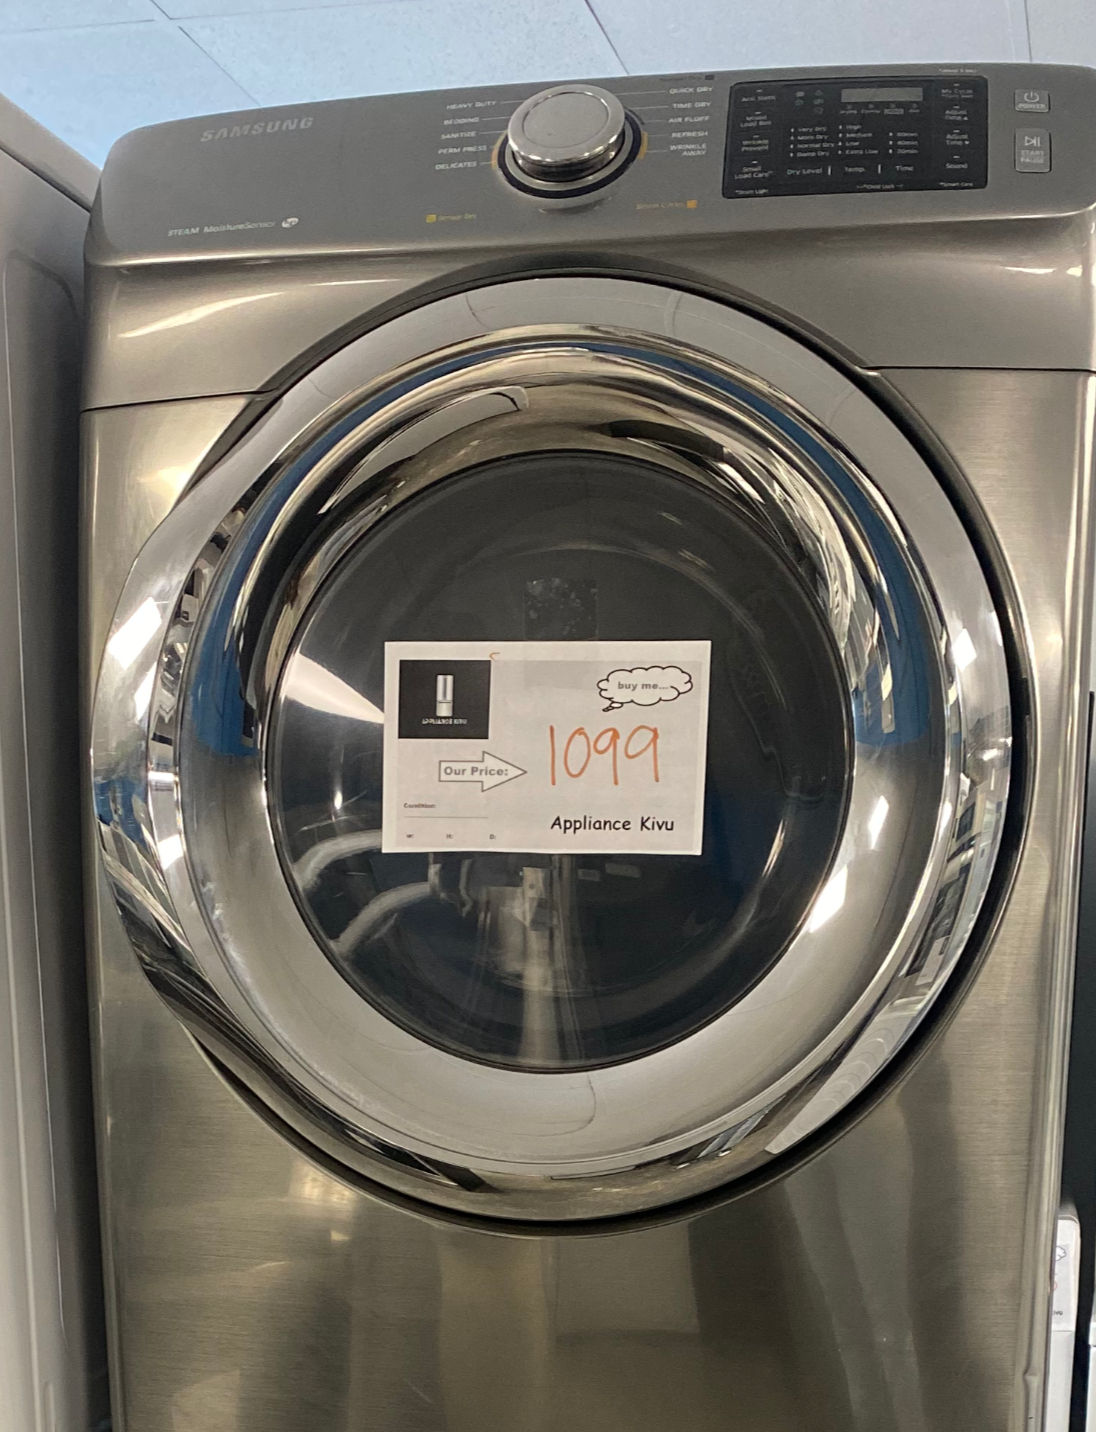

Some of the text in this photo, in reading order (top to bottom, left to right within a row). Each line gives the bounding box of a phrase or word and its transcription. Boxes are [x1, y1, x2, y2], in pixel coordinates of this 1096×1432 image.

[200, 116, 314, 143] SAMSUNG
[435, 161, 477, 170] DELICATES
[168, 227, 200, 237] STEAM
[617, 681, 637, 692] buy
[550, 725, 660, 786] 1099
[444, 766, 508, 776] Our Price:
[550, 815, 675, 834] Appliance Kivu
